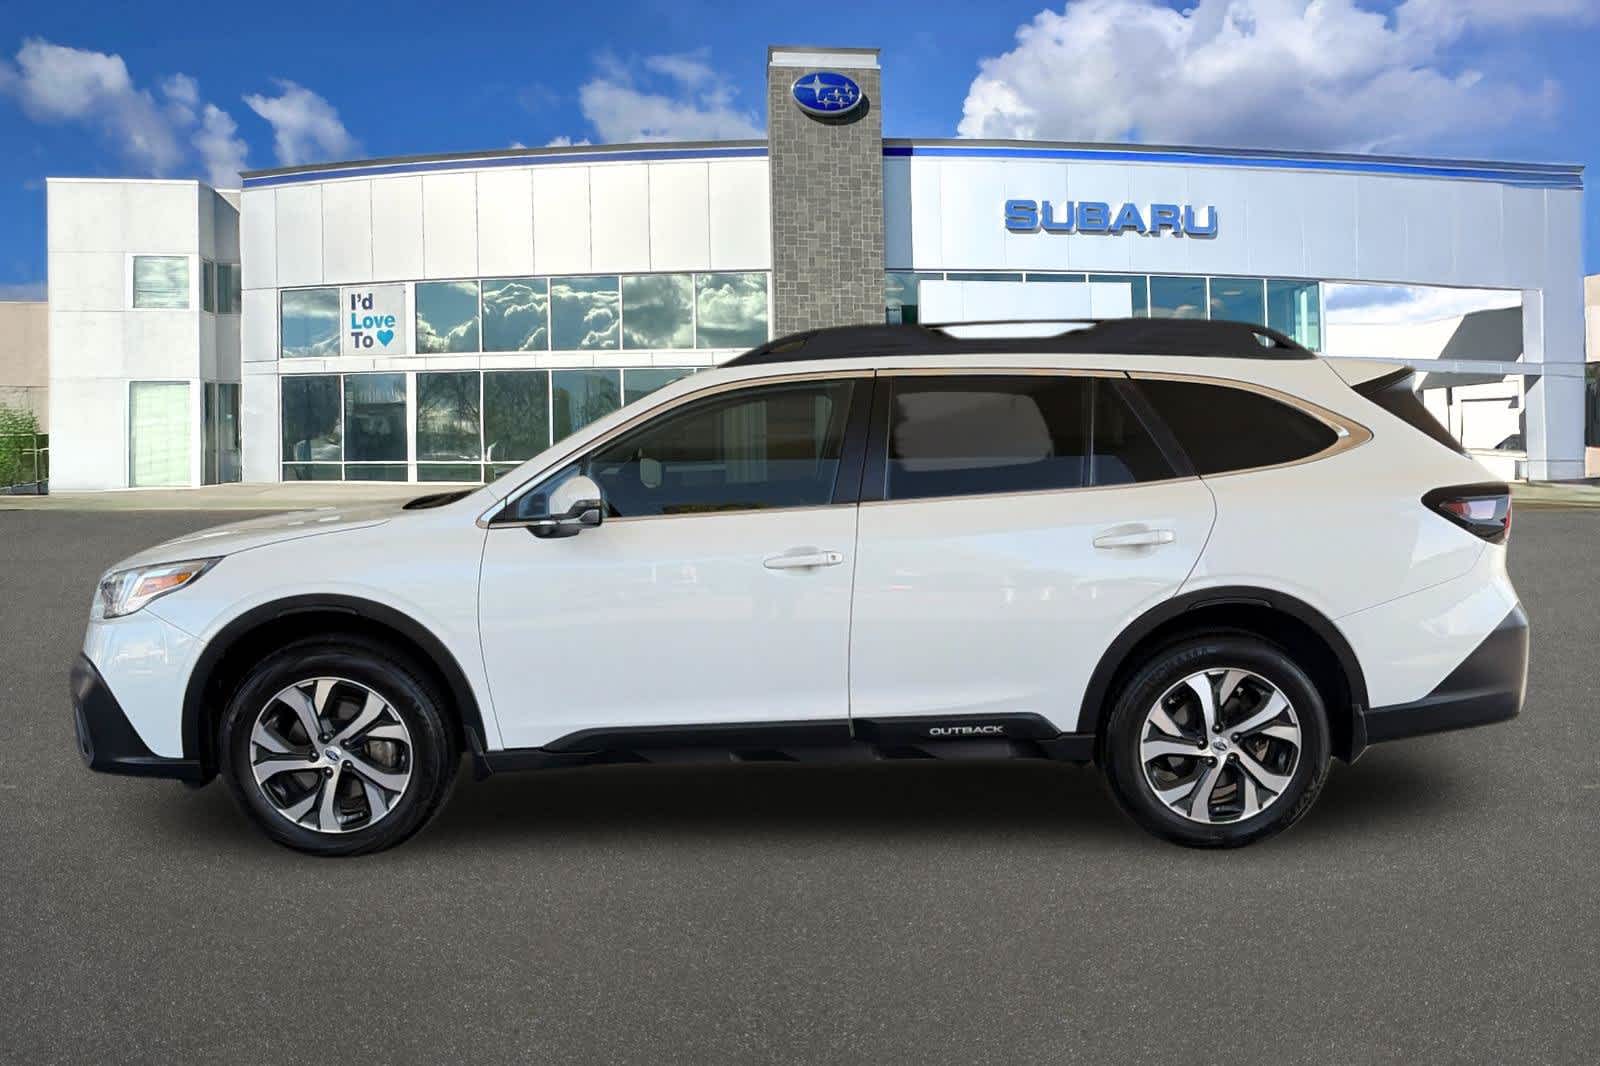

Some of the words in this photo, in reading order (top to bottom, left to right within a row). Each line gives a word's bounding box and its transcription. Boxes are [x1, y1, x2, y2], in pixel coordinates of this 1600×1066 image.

[1005, 199, 1218, 238] SUBARU
[351, 293, 373, 310] I'd
[351, 313, 395, 329] Love
[351, 332, 374, 348] To
[929, 725, 1004, 735] OUTBACK
